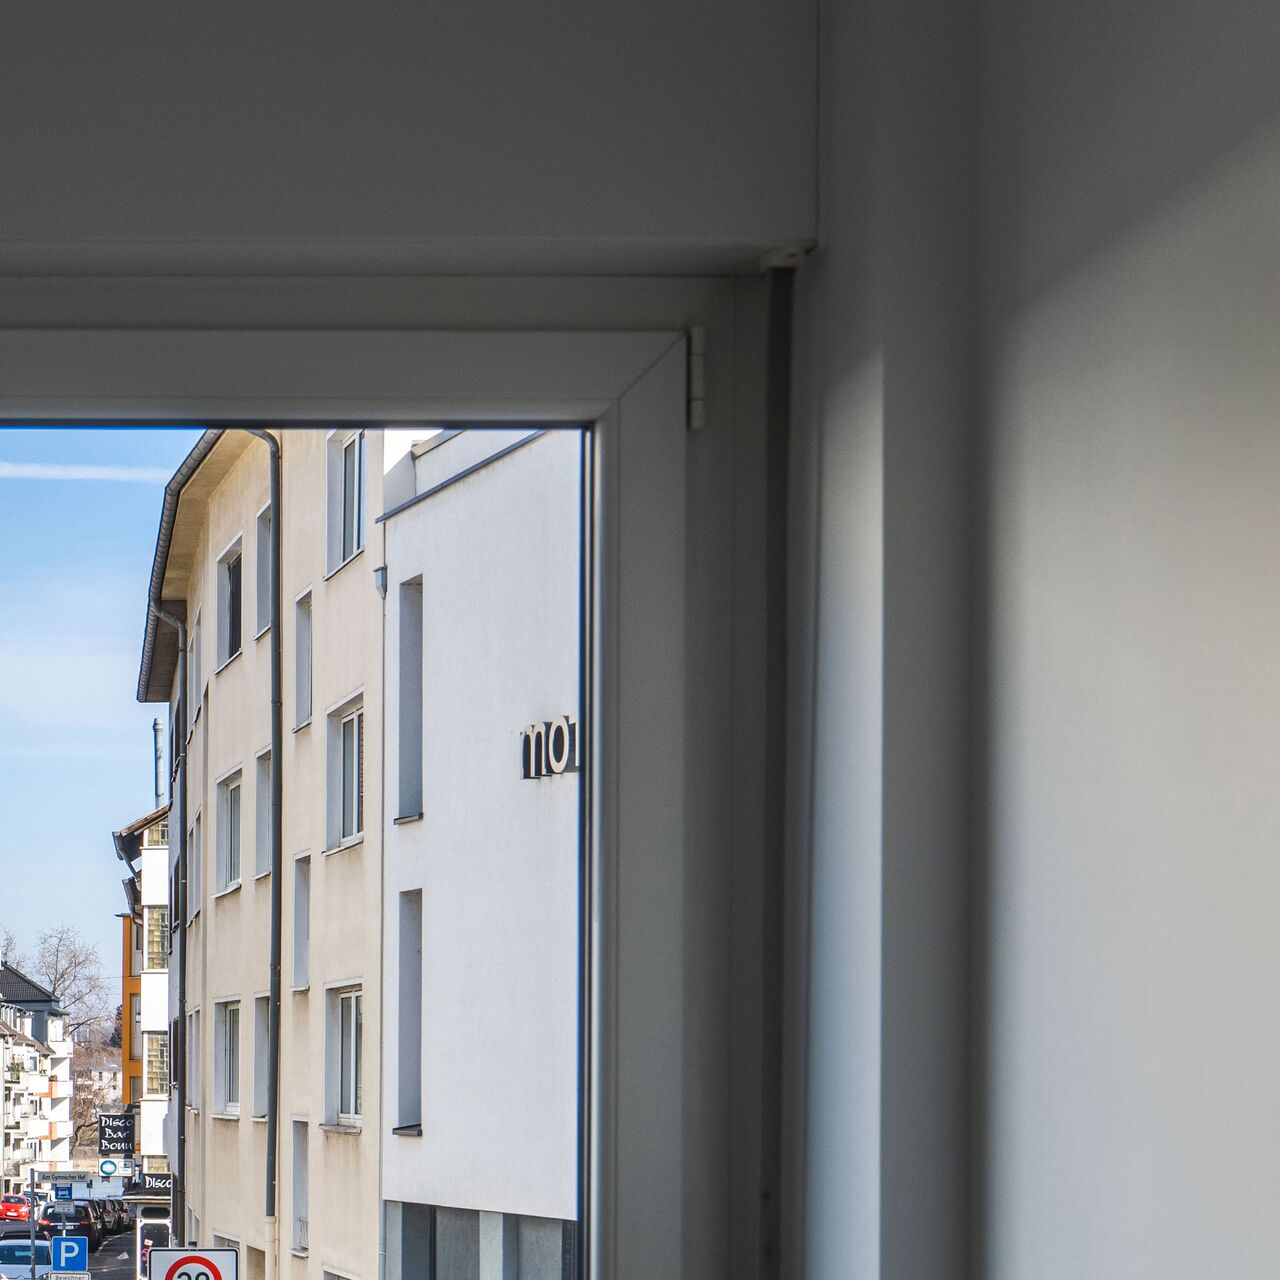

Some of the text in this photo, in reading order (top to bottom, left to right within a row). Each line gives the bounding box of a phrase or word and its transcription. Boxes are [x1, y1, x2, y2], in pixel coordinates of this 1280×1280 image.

[100, 1115, 134, 1127] Disco
[104, 1128, 130, 1139] Bar
[100, 1139, 133, 1150] Bonn
[51, 1173, 77, 1182] Gymnicher
[77, 1173, 86, 1181] Hof
[60, 1241, 79, 1267] P
